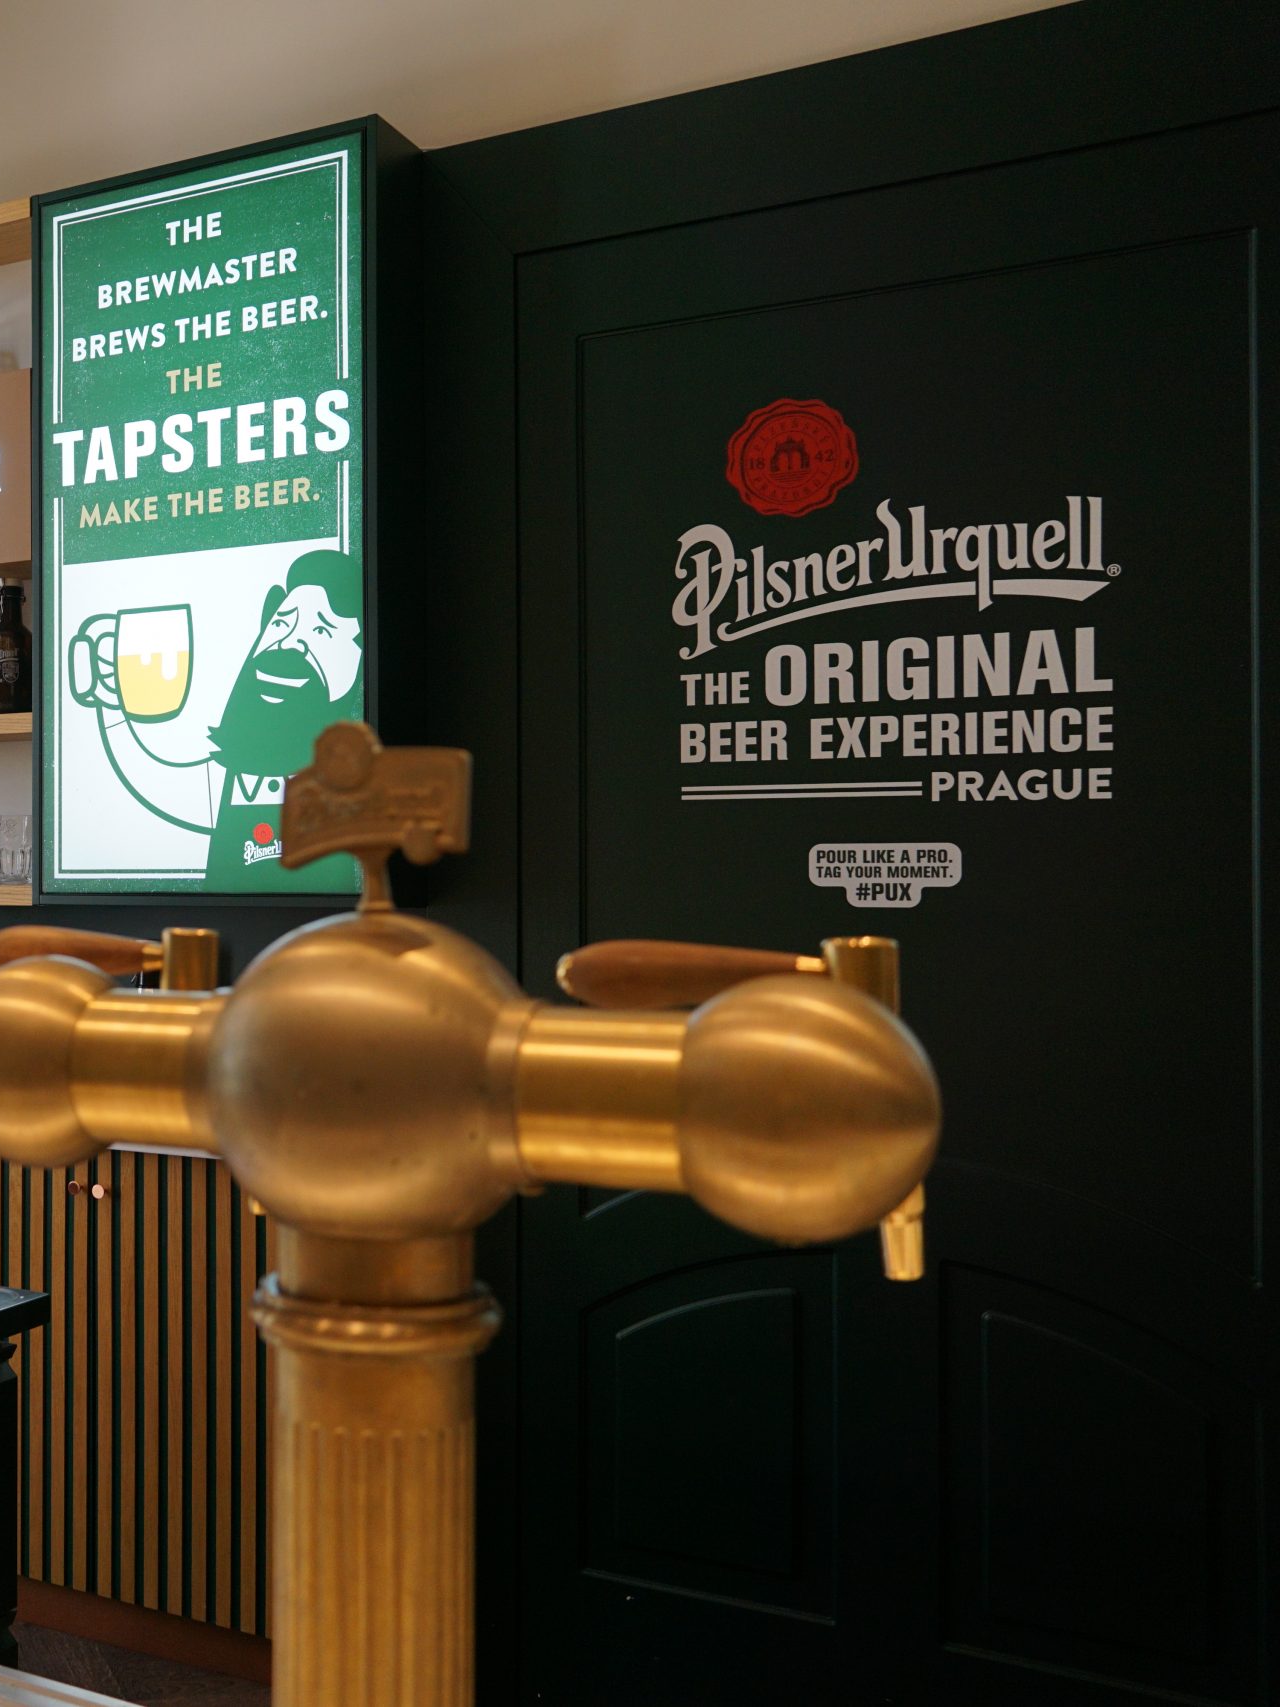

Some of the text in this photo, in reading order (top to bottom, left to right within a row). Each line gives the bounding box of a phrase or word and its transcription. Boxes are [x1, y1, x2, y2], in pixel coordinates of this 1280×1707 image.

[166, 211, 222, 246] THE
[98, 247, 297, 309] BREWMASTER
[72, 295, 328, 362] BREWS THE BEER.
[166, 362, 222, 394] THE
[52, 389, 351, 487] TAPSTERS
[79, 477, 321, 529] MAKE THE BEER.
[672, 524, 884, 660] Pilsner
[680, 626, 1114, 707] THE ORIGINAL
[680, 706, 1114, 763] BEER EXPERIENCE
[931, 767, 1113, 802] PRAGUE
[244, 840, 276, 865] Pilsner
[816, 849, 953, 864] POUR LIKE A PRO.
[816, 866, 953, 879] TAG YOUR MOMENT.
[856, 883, 912, 901] #PUX
